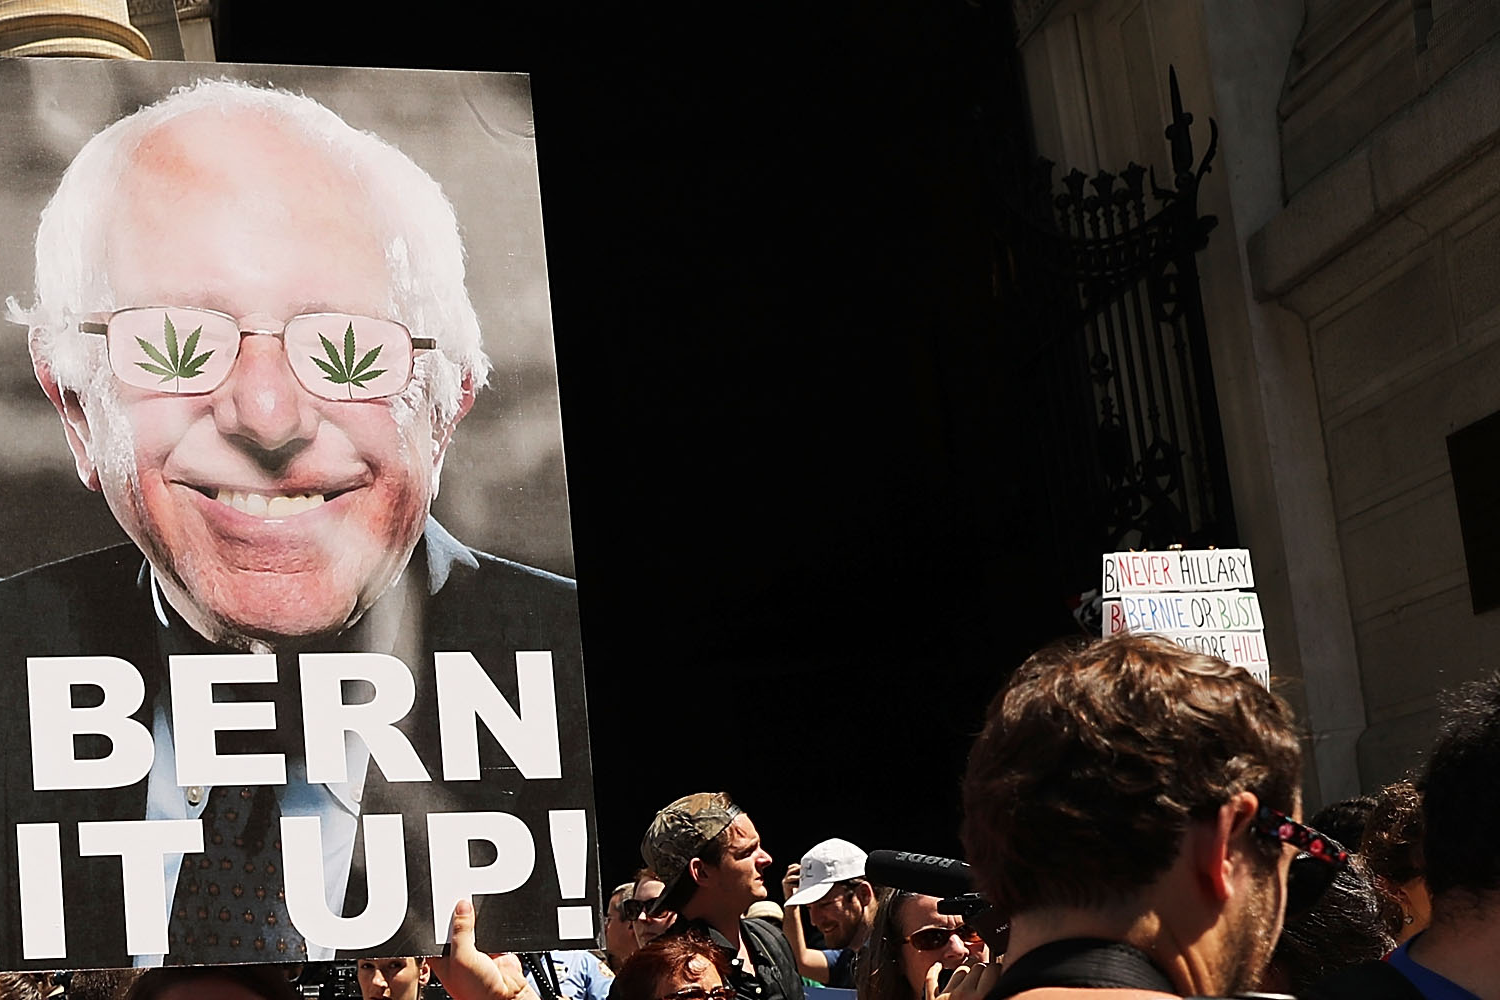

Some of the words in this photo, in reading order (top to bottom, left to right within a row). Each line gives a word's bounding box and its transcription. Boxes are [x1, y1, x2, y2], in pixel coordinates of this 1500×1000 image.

[1118, 555, 1173, 587] NEVER
[1180, 554, 1249, 585] HILLARY
[1125, 597, 1190, 631] BERNIE
[1191, 598, 1216, 628] OR
[1217, 596, 1256, 629] BUST
[1232, 635, 1266, 663] HILL
[26, 650, 563, 791] BERN
[16, 818, 204, 960] IT
[280, 809, 594, 950] UP!
